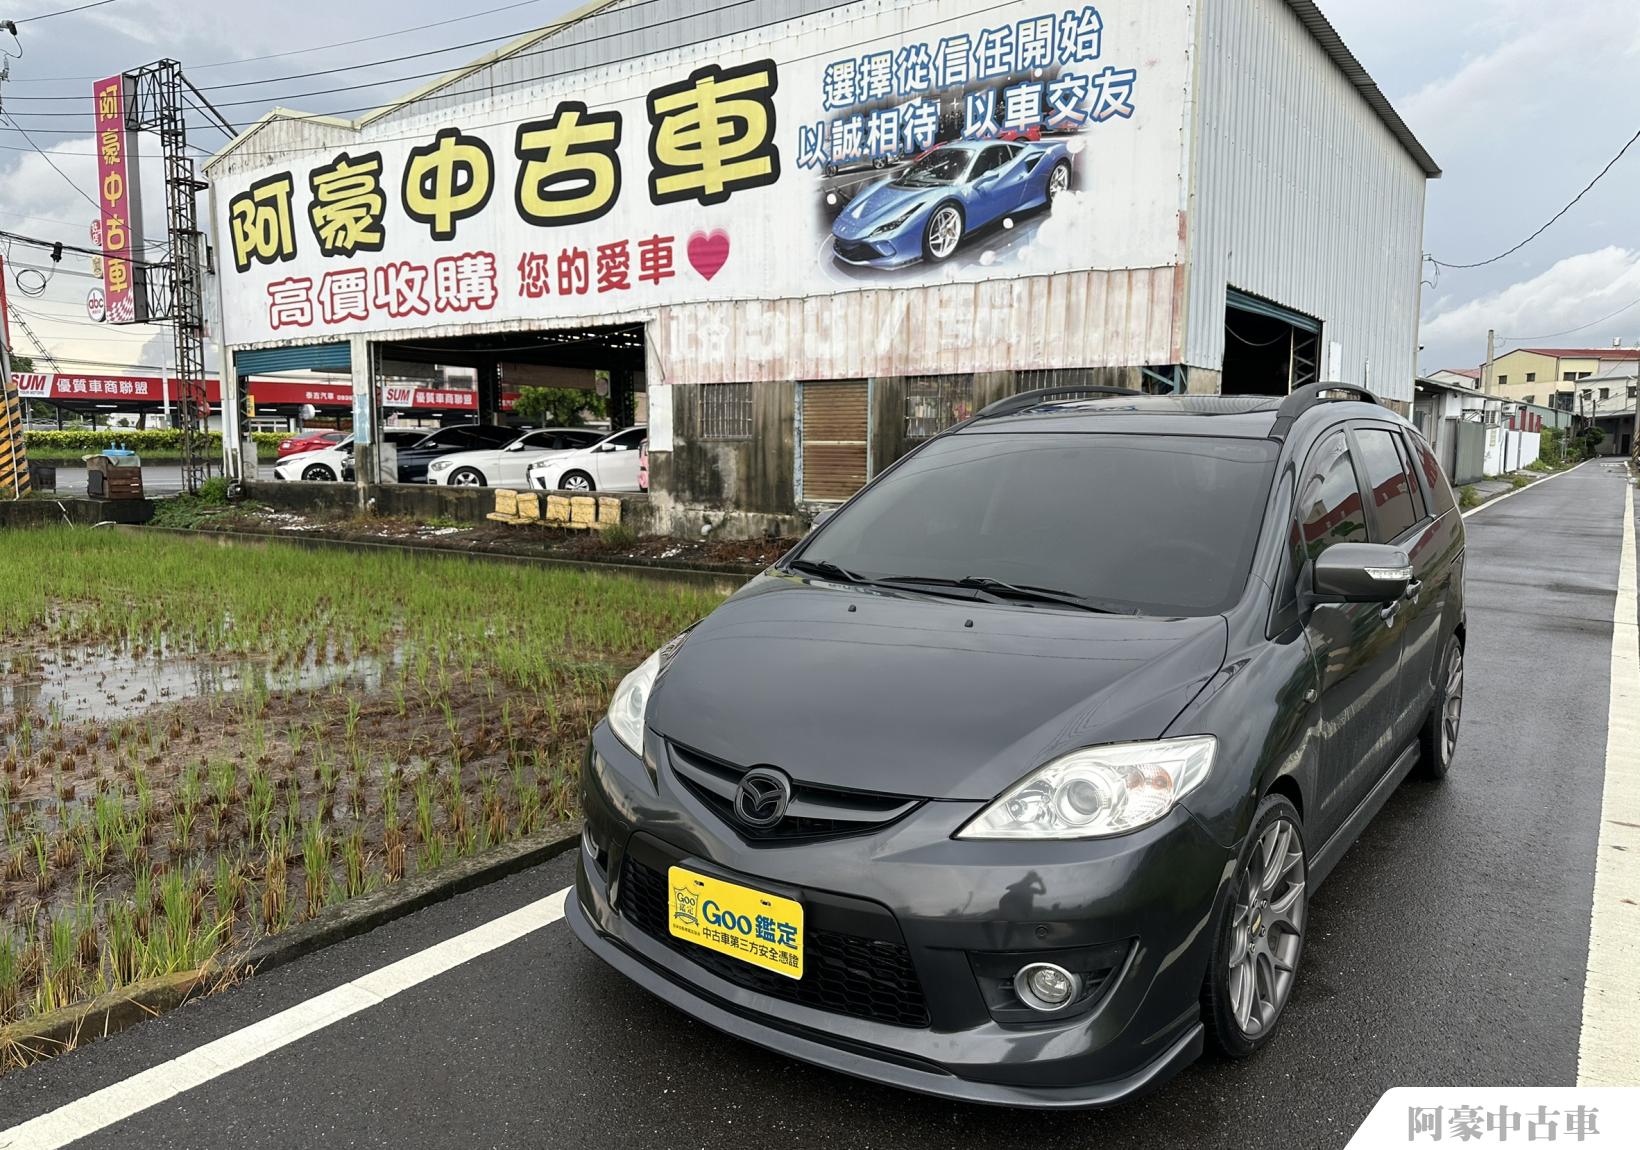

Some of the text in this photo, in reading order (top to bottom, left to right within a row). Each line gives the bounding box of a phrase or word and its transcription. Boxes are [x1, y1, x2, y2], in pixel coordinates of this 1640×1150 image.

[823, 6, 1103, 110] 選擇從信任開始
[795, 66, 1136, 171] 以誠相待 以車交友
[99, 84, 128, 293] 阿豪中古車
[229, 58, 780, 273] 阿豪中古車
[267, 234, 676, 330] 高價收購 您的愛車
[12, 374, 46, 391] SUM
[56, 378, 149, 395] 優質車商聯盟
[386, 388, 410, 401] SUM
[702, 900, 798, 950] Goo 鑑定
[702, 927, 799, 969] 中古車第三方安全憑證
